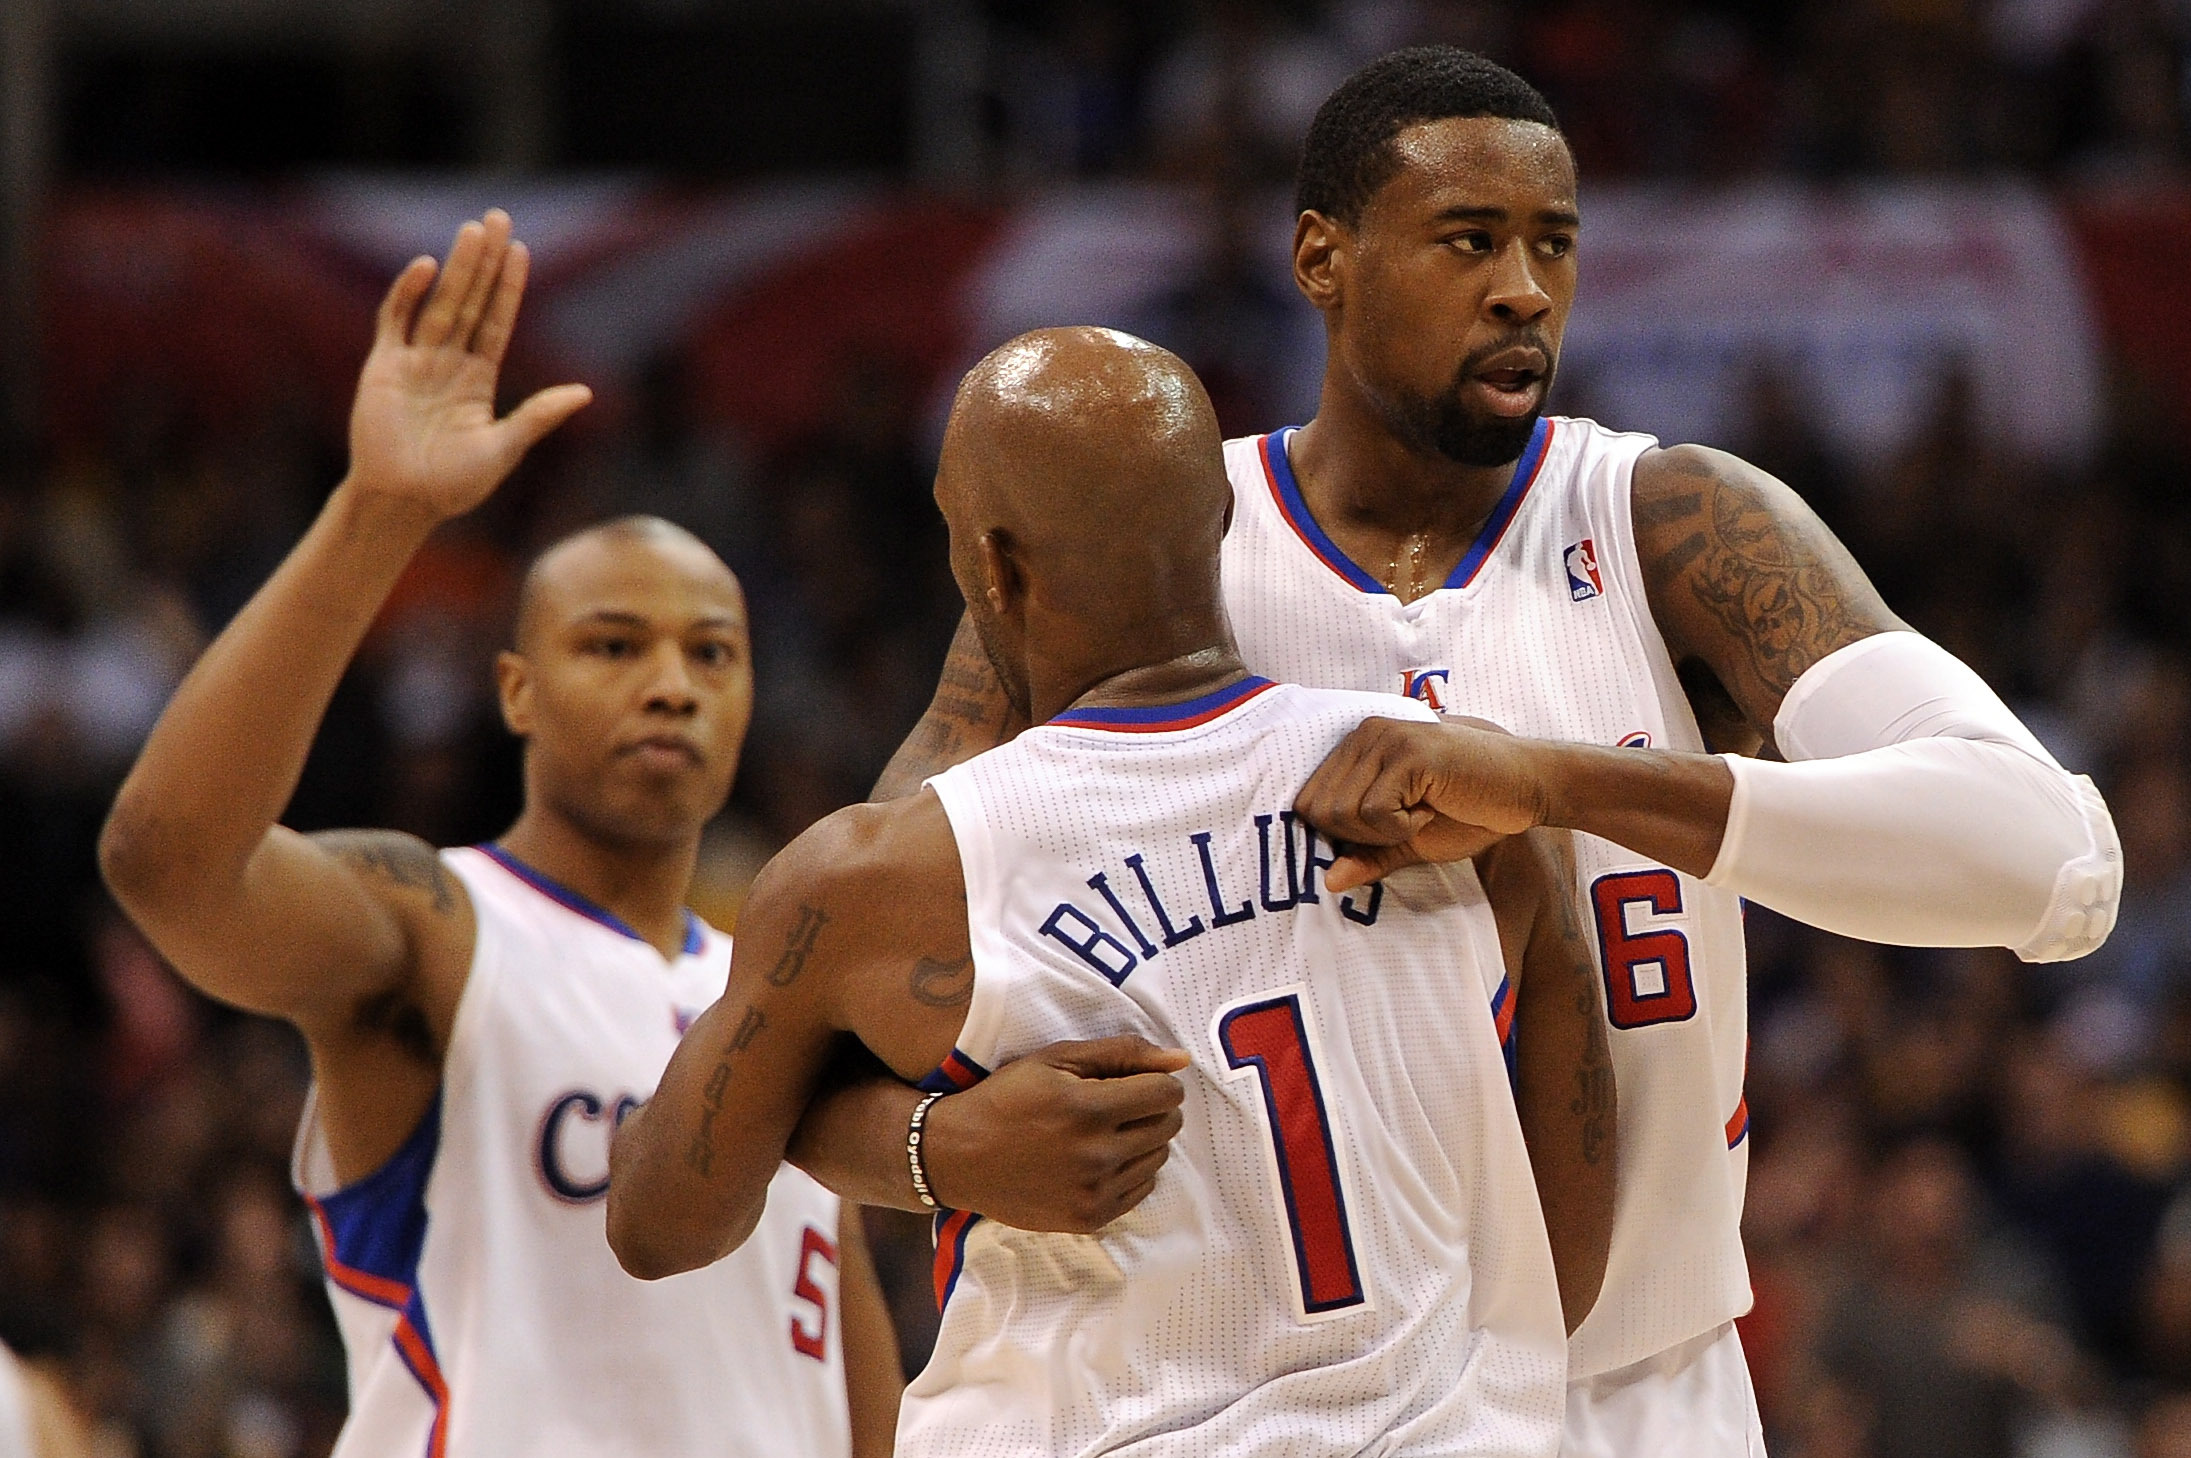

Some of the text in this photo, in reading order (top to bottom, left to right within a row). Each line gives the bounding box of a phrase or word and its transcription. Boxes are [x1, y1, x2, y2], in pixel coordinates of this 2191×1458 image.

[1573, 586, 1595, 601] NBA
[1590, 868, 1697, 1030] 6
[1218, 994, 1363, 1312] 1
[791, 1226, 838, 1361] 5
